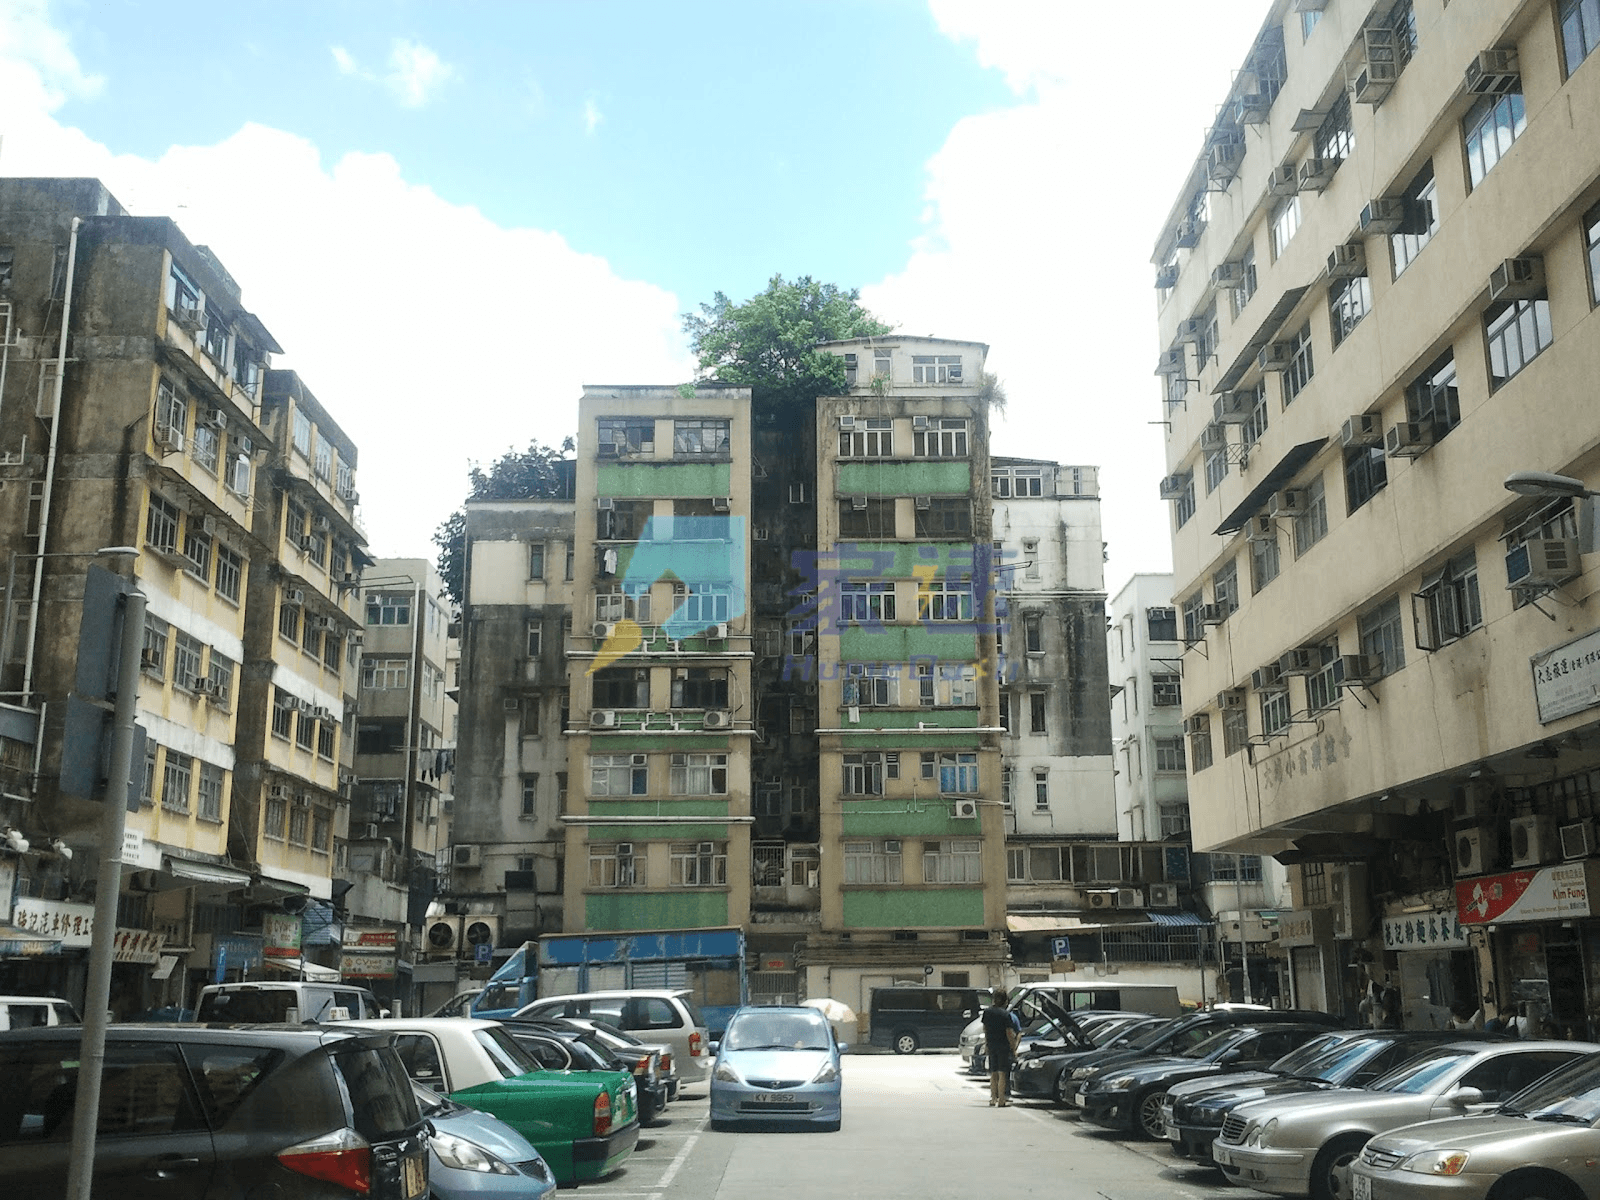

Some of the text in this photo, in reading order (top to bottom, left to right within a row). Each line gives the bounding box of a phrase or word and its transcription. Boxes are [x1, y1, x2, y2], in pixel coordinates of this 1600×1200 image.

[1567, 888, 1586, 900] Fung
[478, 945, 489, 958] P
[1054, 939, 1066, 954] P
[755, 1093, 767, 1102] KV
